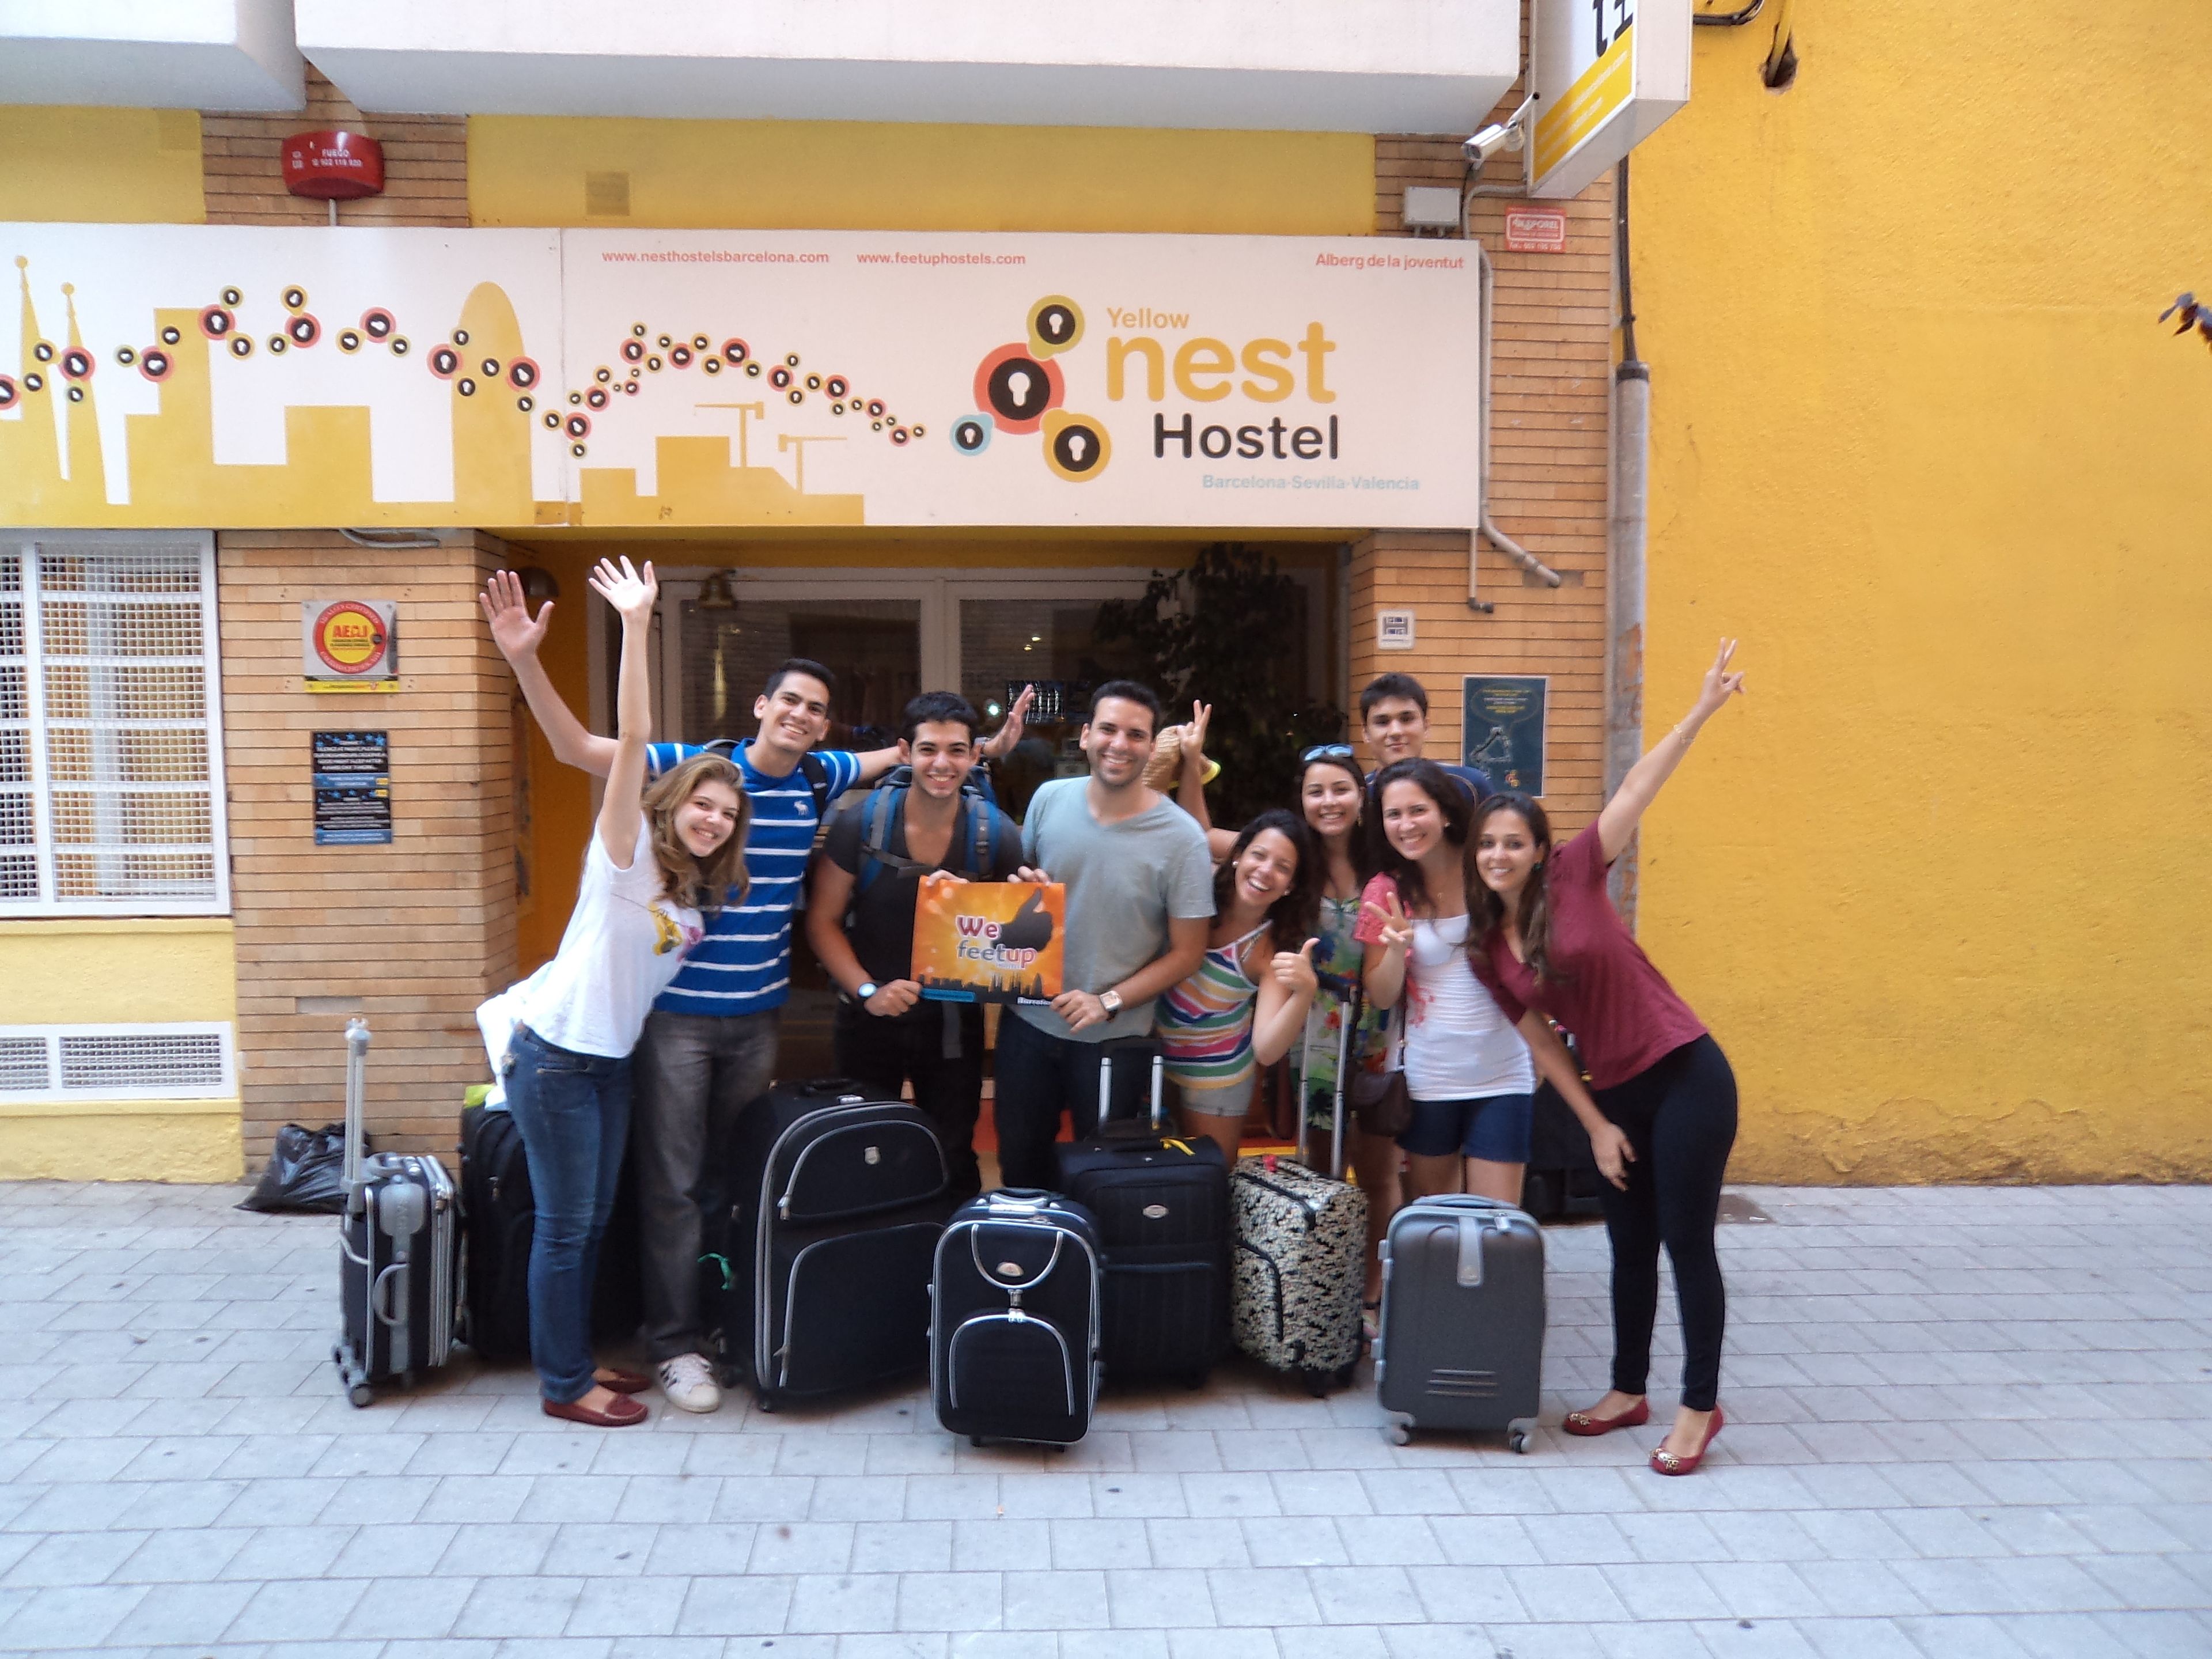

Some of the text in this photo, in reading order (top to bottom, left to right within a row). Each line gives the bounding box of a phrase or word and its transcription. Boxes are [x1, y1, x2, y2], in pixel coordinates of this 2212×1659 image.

[322, 149, 350, 157] FUEGO
[601, 251, 1027, 266] www.nesthostelsbarcelona.com www.feetuphostels.com
[1316, 253, 1464, 270] Alberg de la joventut
[1107, 307, 1190, 329] Yellow
[1106, 321, 1336, 403] nest
[1153, 412, 1339, 460] Hostel
[957, 916, 1000, 939] We
[957, 940, 1036, 968] feetup
